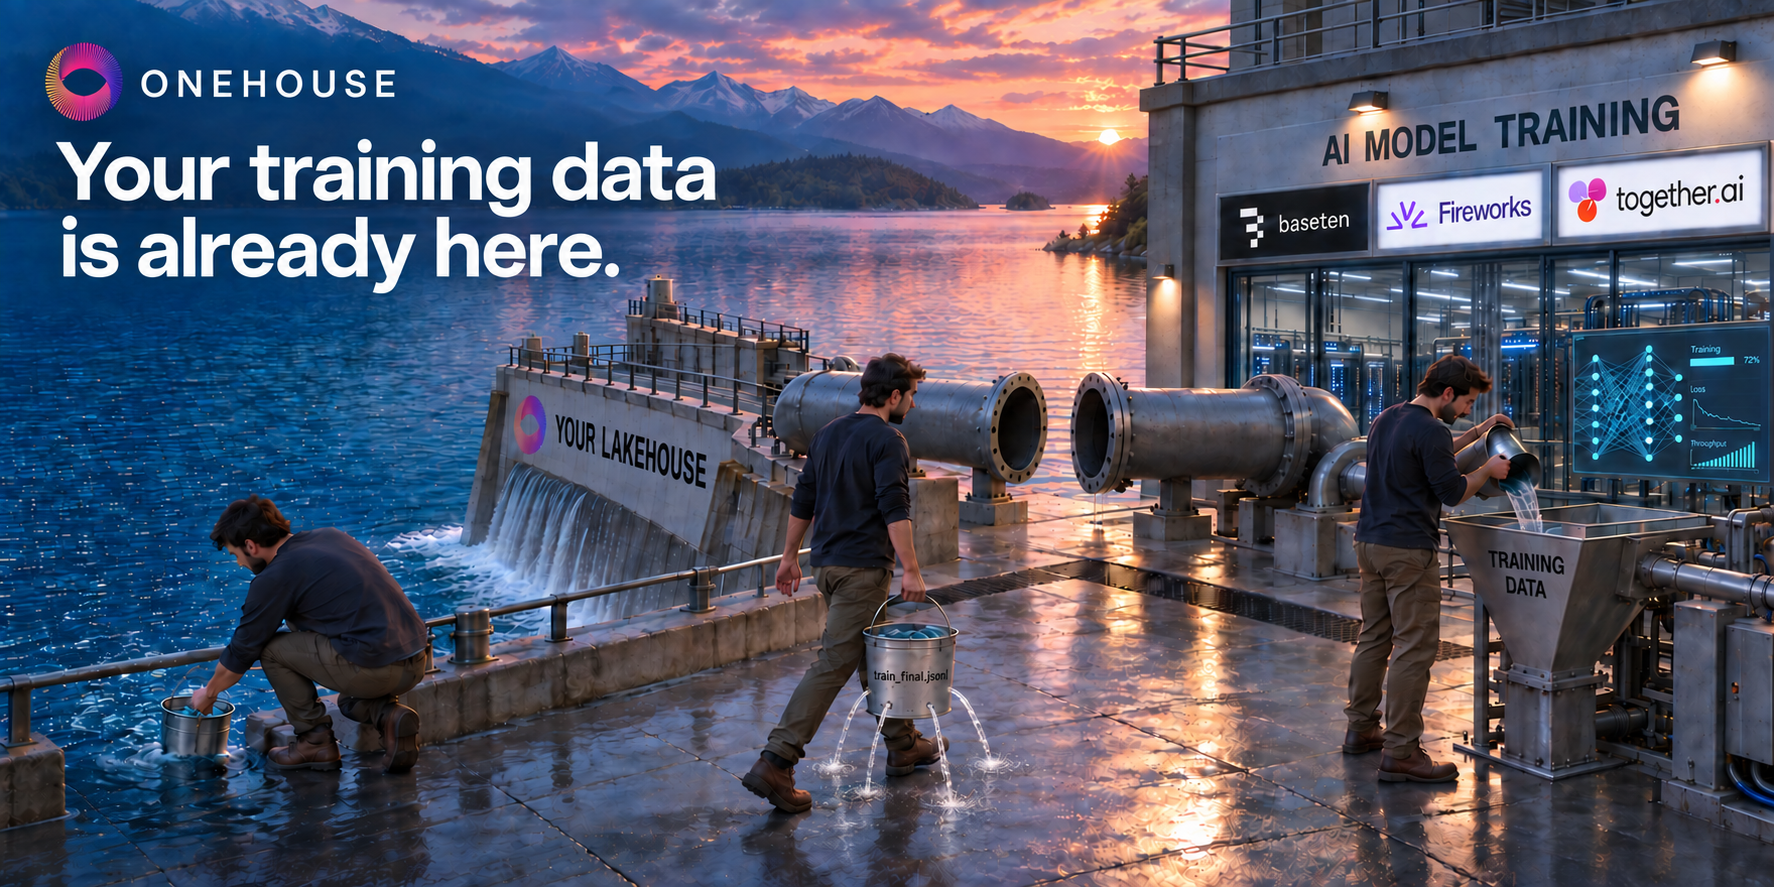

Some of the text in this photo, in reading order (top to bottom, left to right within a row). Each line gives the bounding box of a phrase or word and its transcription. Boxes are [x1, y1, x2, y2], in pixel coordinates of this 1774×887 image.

[1322, 95, 1681, 167] AI MODEL TRAINING
[1616, 174, 1745, 218] together.ai
[1278, 210, 1350, 235] baseten
[1438, 196, 1533, 225] Fireworks
[1690, 345, 1721, 355] Training
[1743, 355, 1760, 364] 72%
[555, 414, 707, 489] YOUR LAKEHOUSE
[1488, 550, 1565, 575] TRAINING
[1505, 575, 1547, 599] DATA
[874, 669, 949, 684] train_final.jsonl
